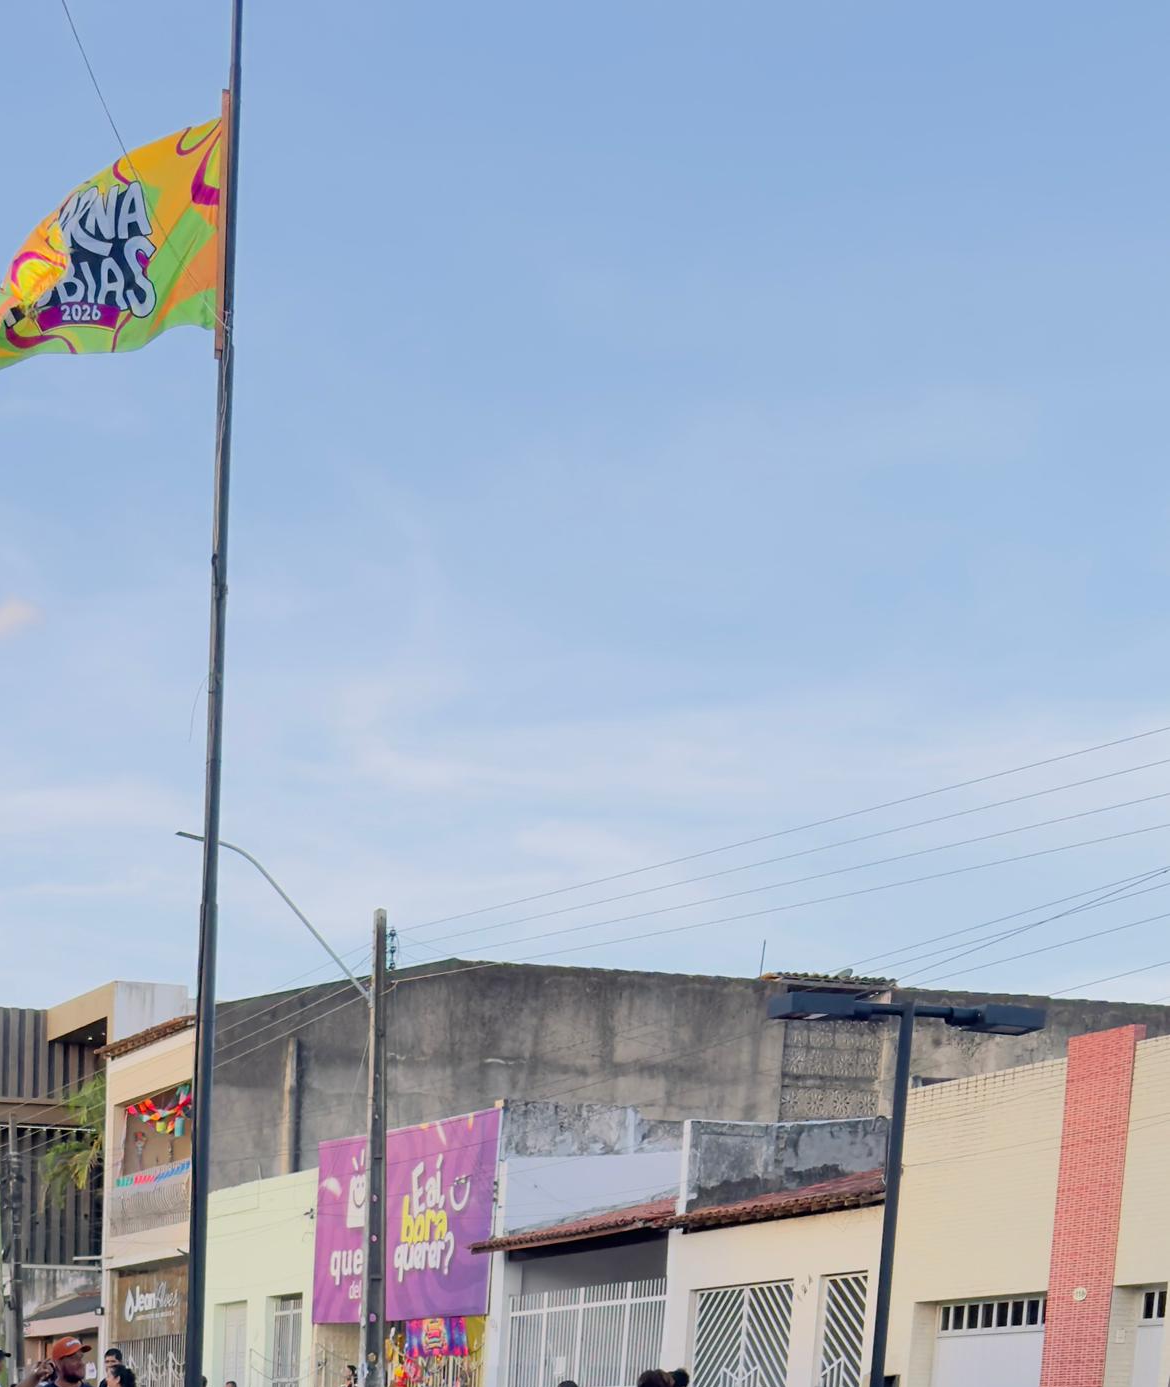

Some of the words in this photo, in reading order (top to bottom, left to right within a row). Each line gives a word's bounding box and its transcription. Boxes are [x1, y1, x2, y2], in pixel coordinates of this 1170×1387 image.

[37, 235, 157, 319] BIAS
[60, 304, 102, 322] 2026
[401, 1195, 448, 1244] bora
[330, 1248, 363, 1286] que
[393, 1231, 455, 1283] querer?
[134, 1286, 156, 1313] Jean
[348, 1279, 363, 1300] del
